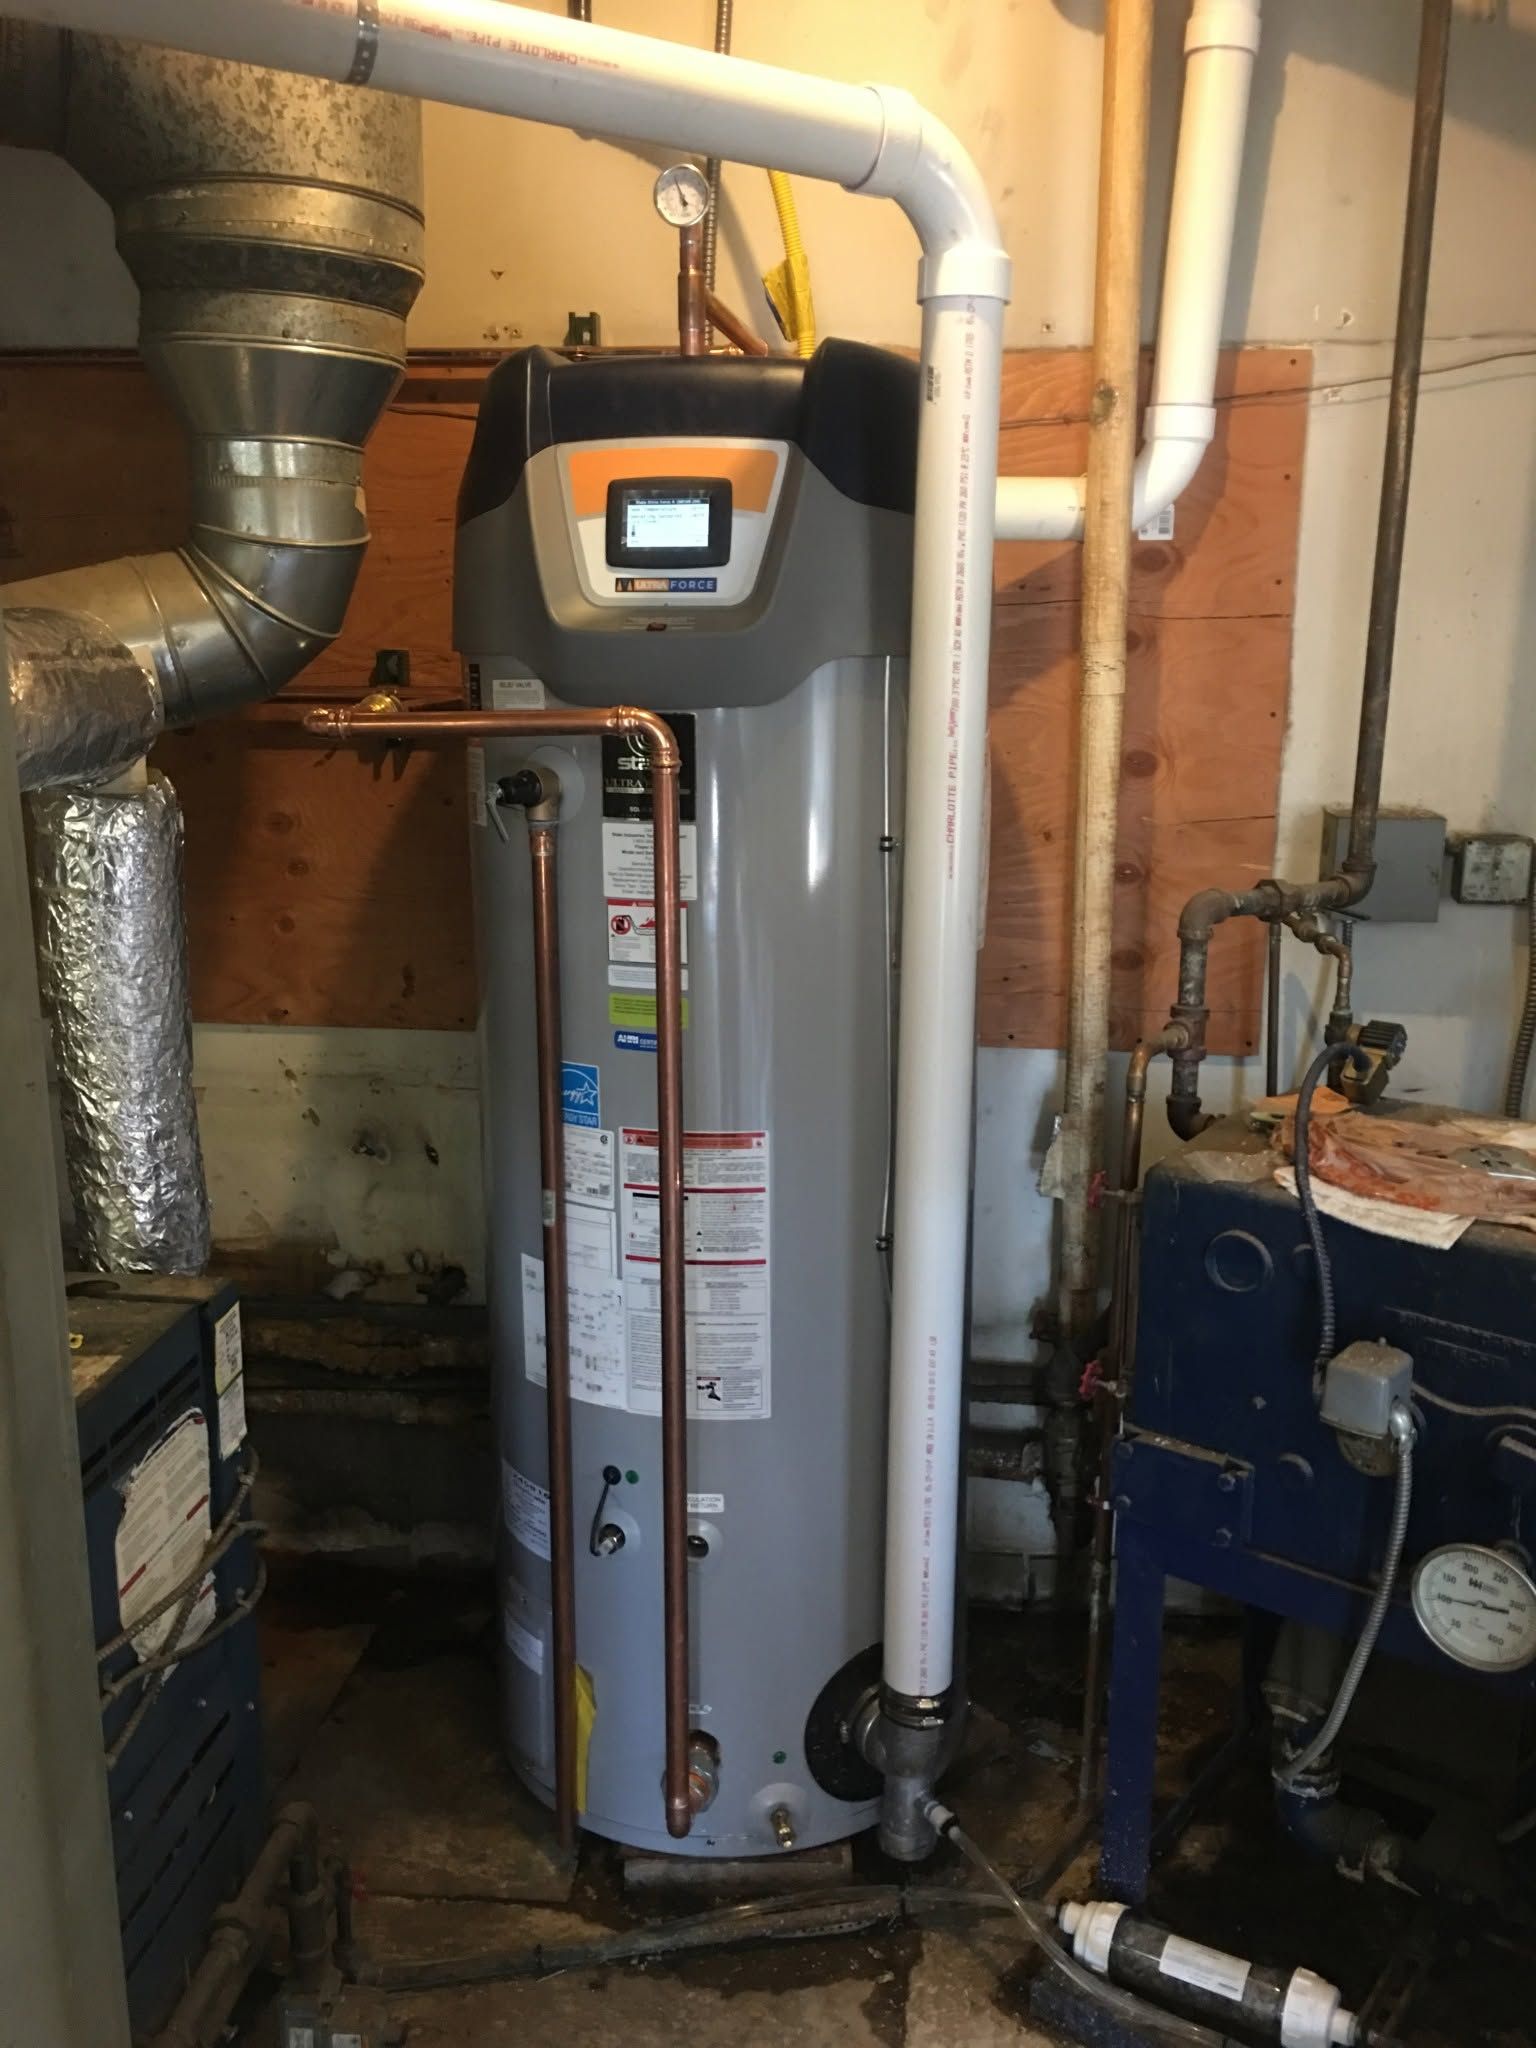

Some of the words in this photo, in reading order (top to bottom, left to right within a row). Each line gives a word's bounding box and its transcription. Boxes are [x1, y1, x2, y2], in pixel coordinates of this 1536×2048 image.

[471, 30, 500, 49] PIPE
[508, 38, 577, 66] CHARLOTTE
[670, 581, 713, 590] FORCE
[948, 752, 958, 779] PIPE
[945, 784, 957, 845] CHARLOTTE
